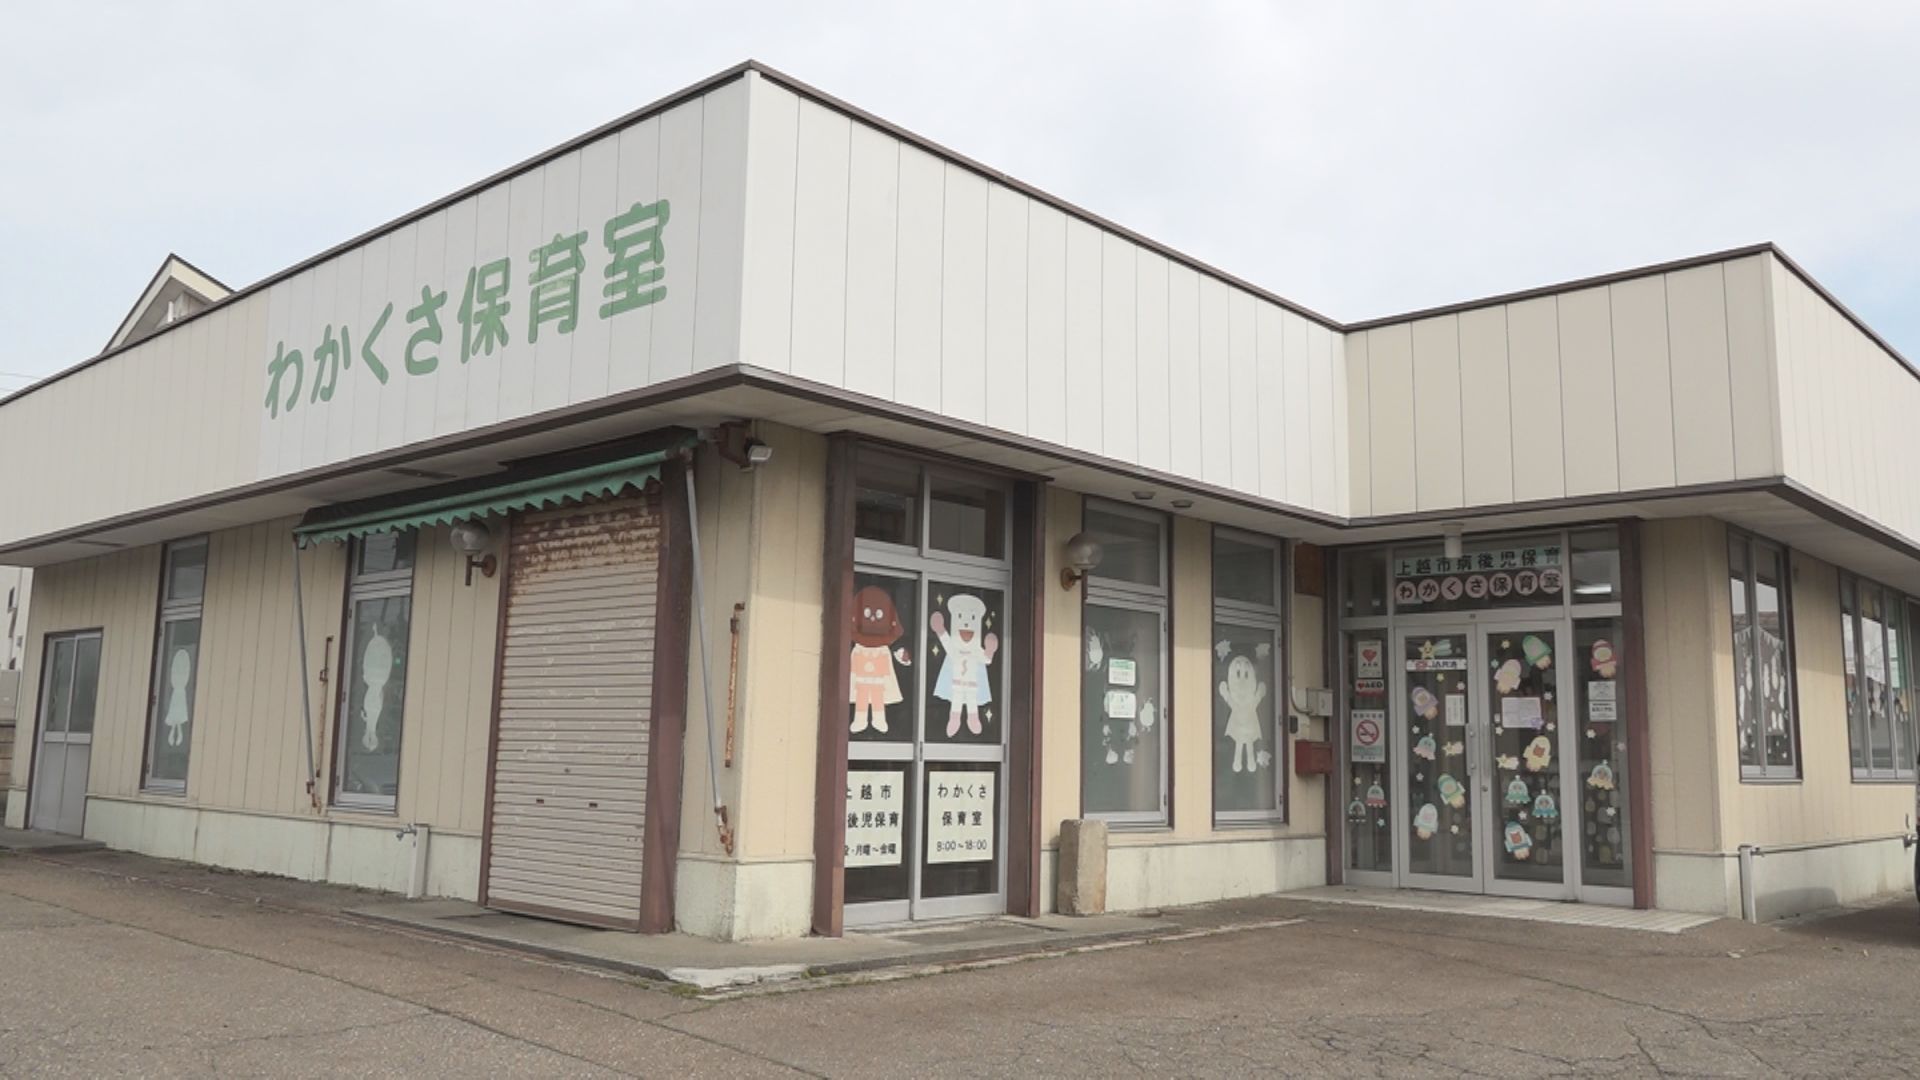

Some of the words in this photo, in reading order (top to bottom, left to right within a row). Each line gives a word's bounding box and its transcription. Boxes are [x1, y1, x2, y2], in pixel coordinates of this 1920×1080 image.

[265, 199, 670, 420] わかくさ保育室
[1396, 547, 1560, 576] 上越市病後児保育
[1400, 573, 1560, 600] わかくさ保育室
[937, 783, 987, 799] わかくさ
[942, 811, 982, 826] 保育室
